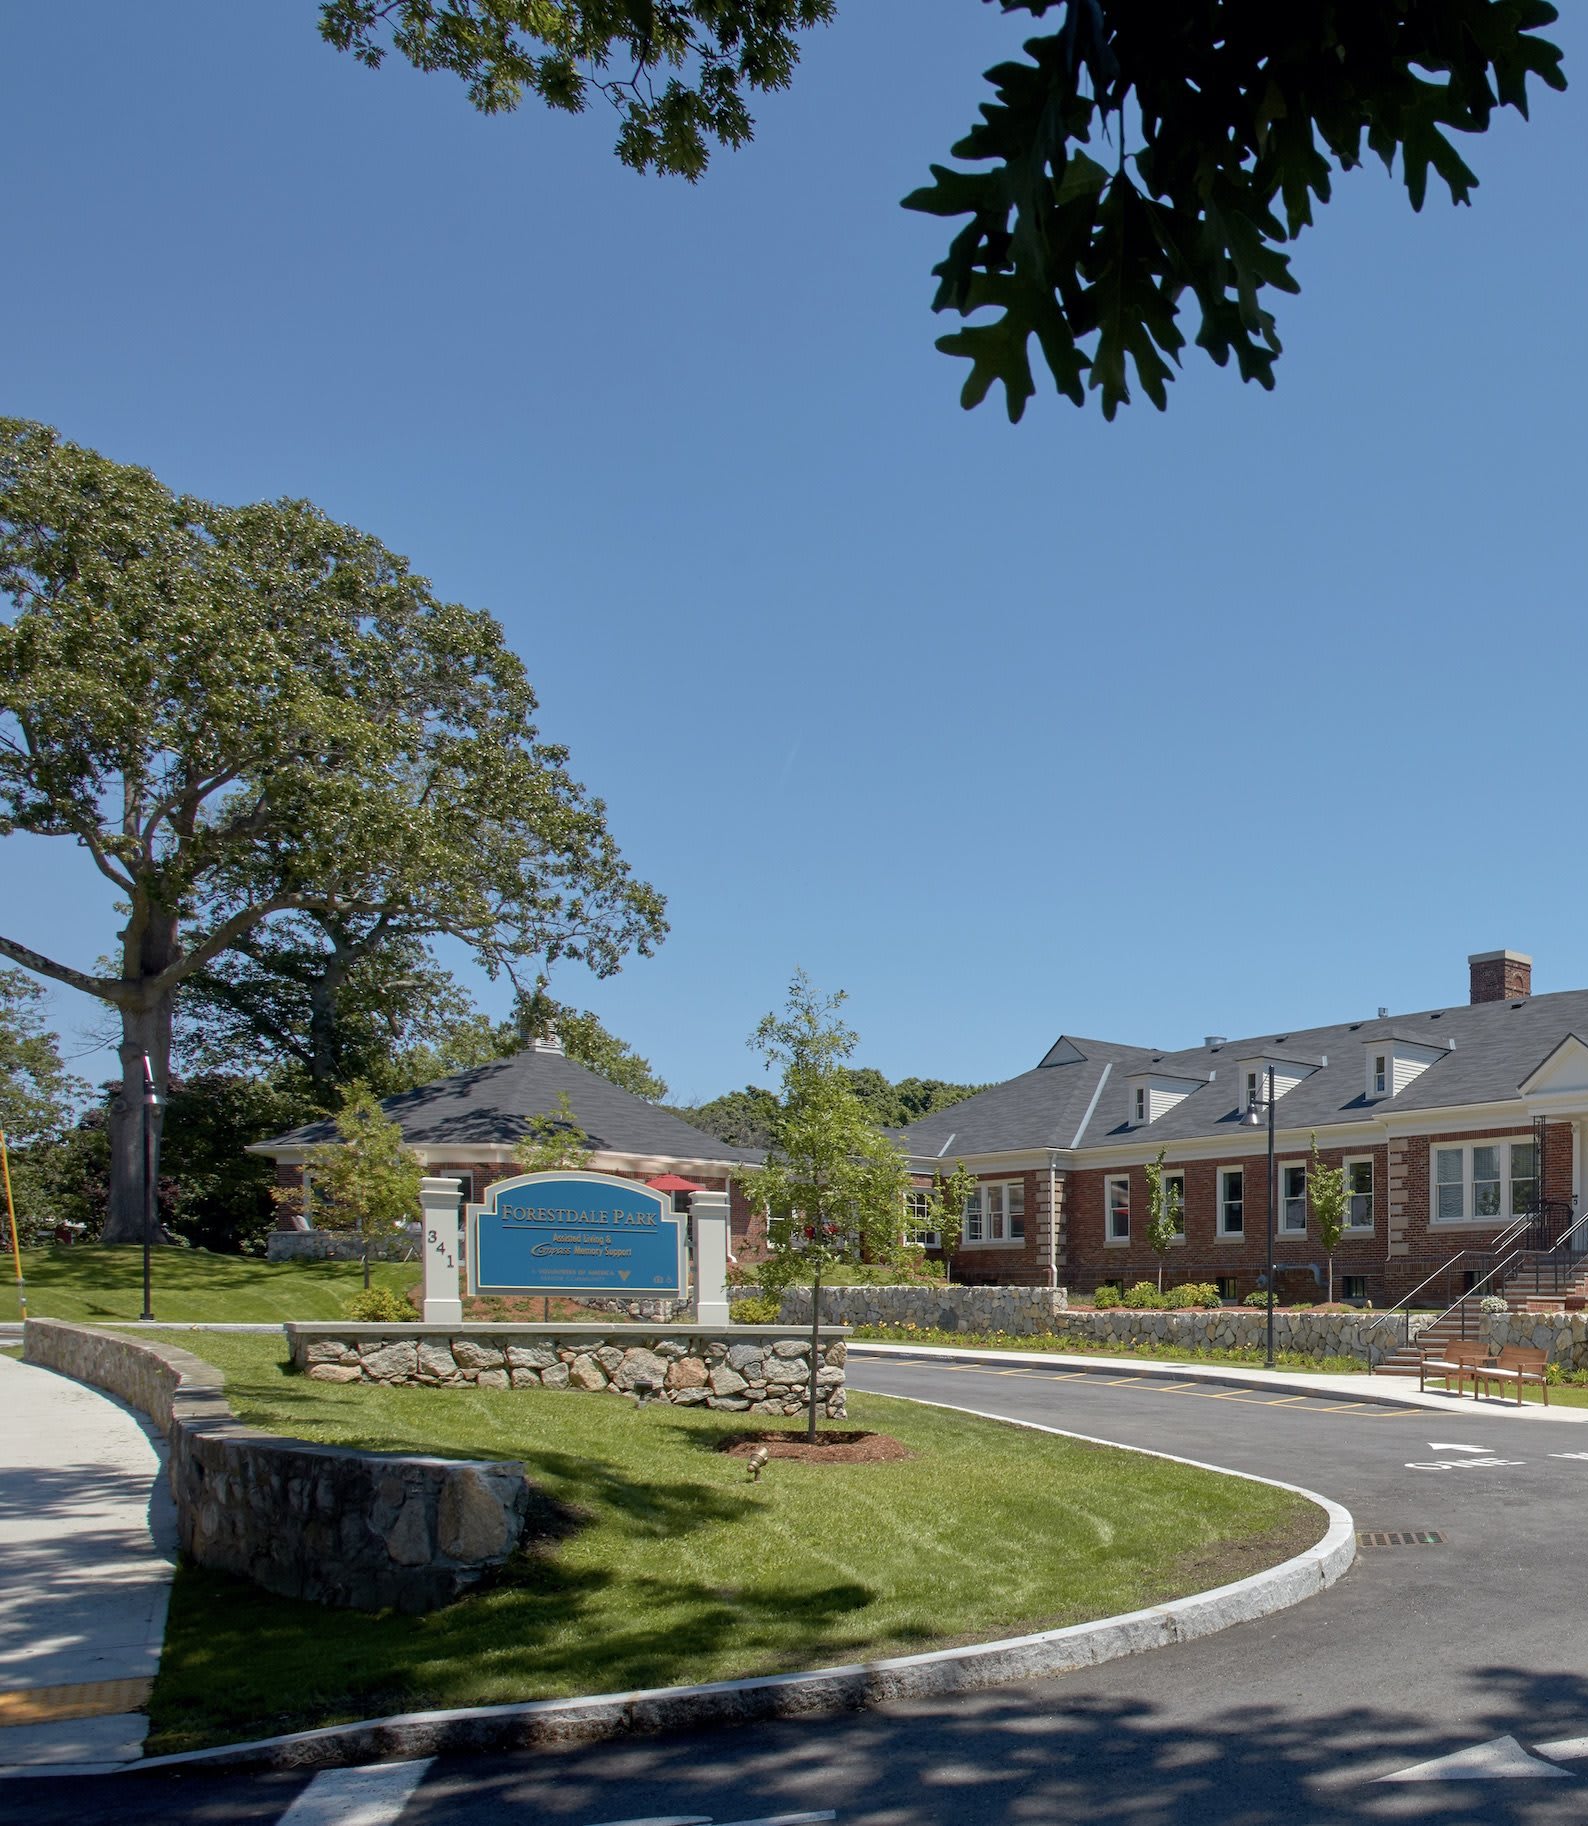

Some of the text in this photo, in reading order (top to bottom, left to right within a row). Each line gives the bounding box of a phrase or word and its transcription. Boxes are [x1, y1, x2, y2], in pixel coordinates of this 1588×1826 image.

[501, 1204, 658, 1226] FORESTDALE PARK
[553, 1233, 612, 1246] Assisted Living &
[427, 1230, 454, 1268] 341
[531, 1242, 632, 1258] Compass Memory Support
[1404, 1457, 1527, 1470] ONE
